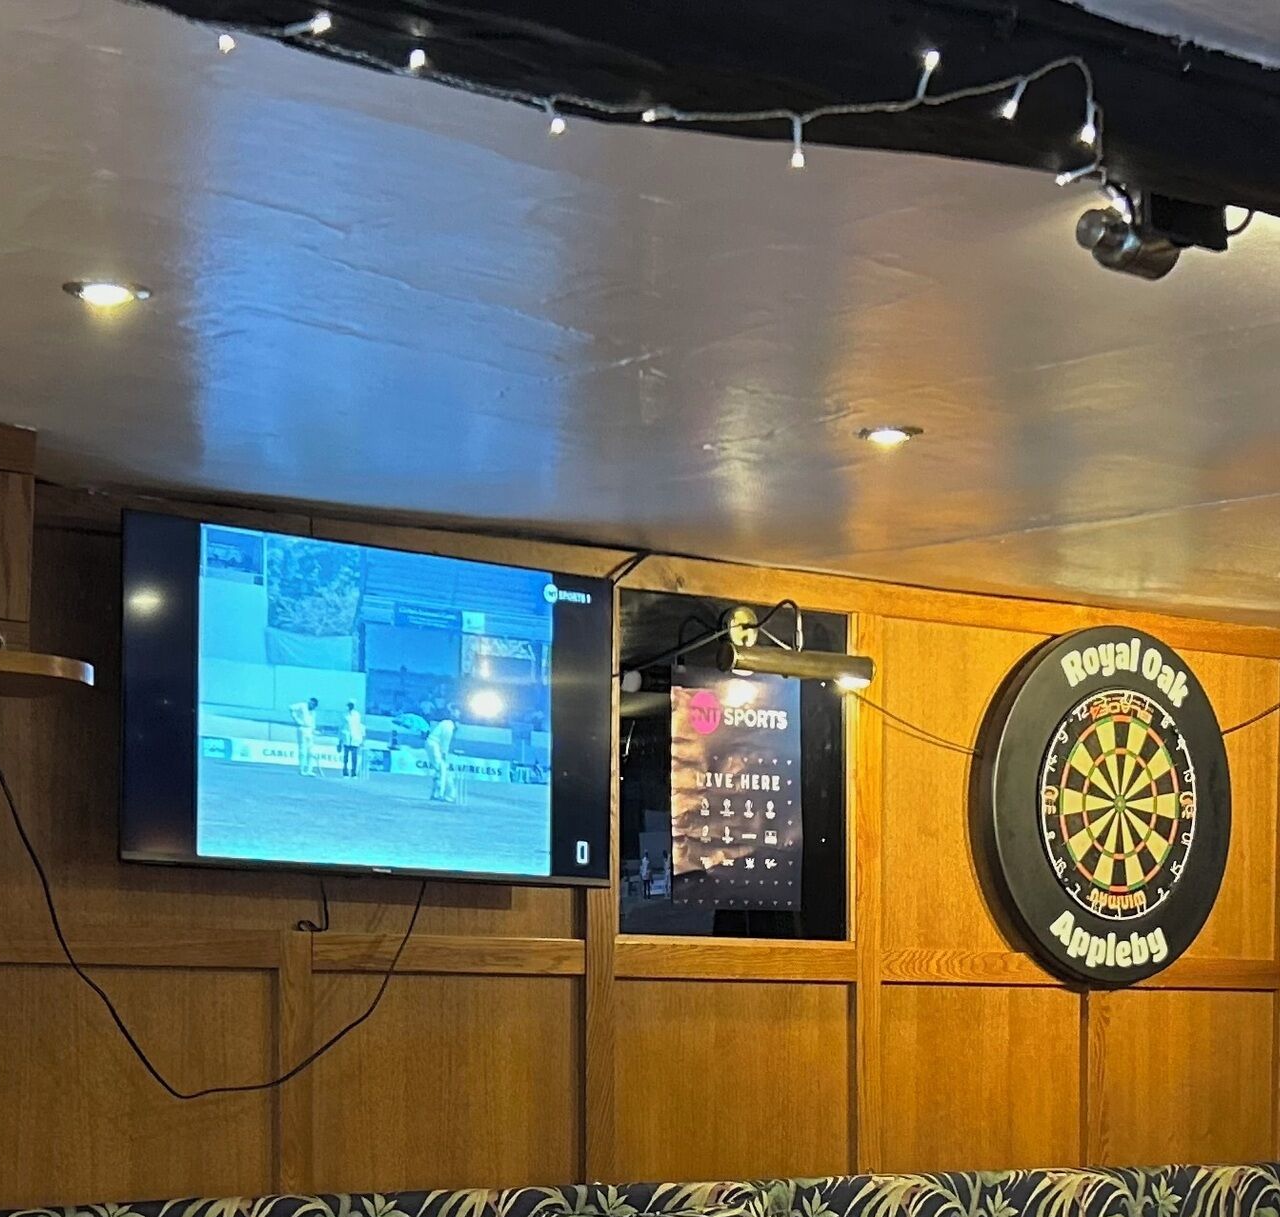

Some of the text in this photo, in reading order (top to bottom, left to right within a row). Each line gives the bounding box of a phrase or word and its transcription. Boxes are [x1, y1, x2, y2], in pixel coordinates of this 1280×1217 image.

[1060, 637, 1189, 708] Royal Oak
[723, 707, 789, 730] SPORTS
[695, 771, 781, 792] LIVE HERE
[1049, 909, 1169, 968] Appleby
